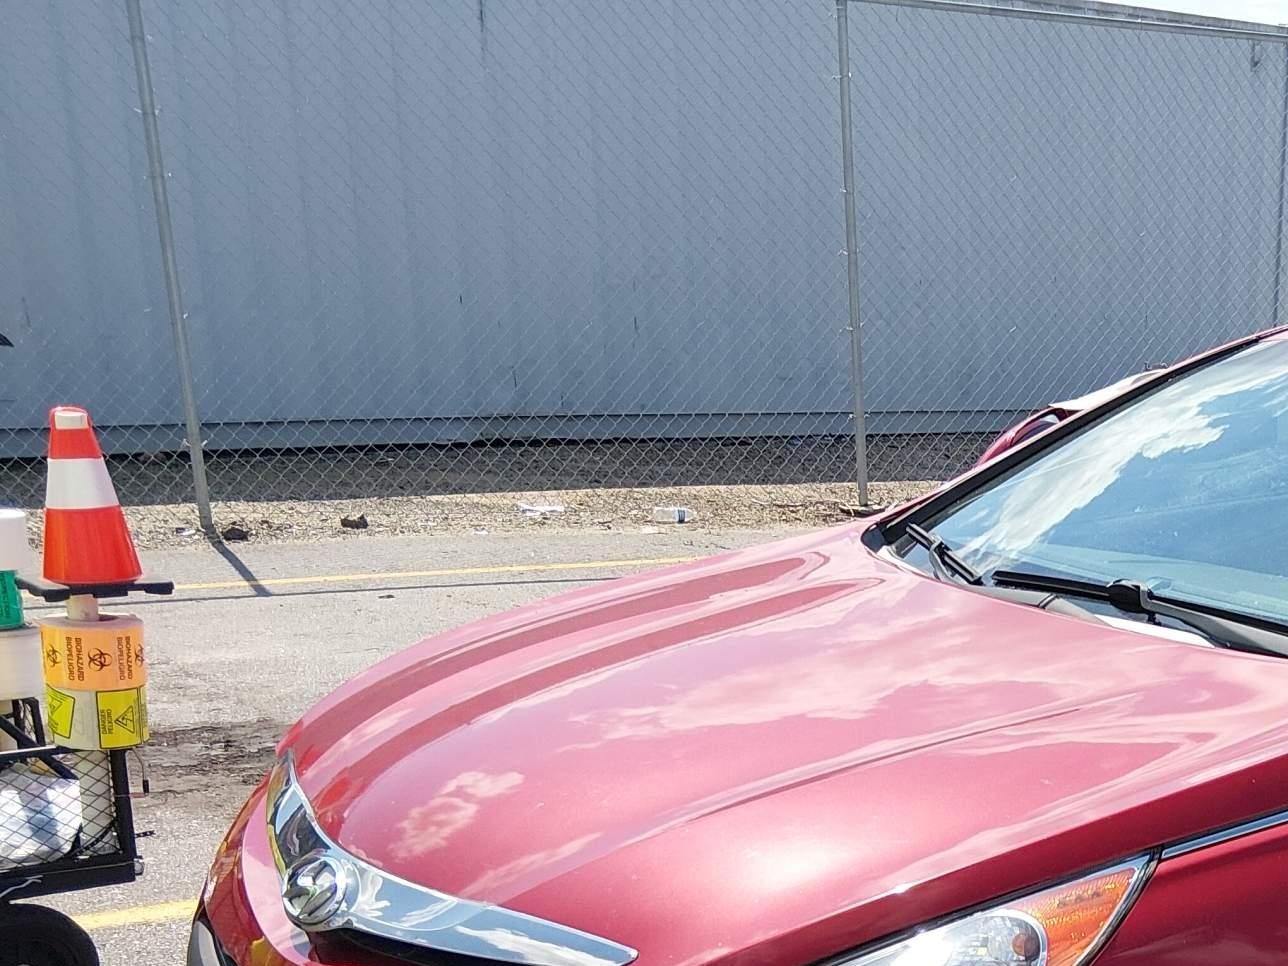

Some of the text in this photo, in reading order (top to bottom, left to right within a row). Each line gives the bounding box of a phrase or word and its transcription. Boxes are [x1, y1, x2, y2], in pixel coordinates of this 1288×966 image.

[65, 636, 75, 681] BIOPELIGRO
[74, 637, 84, 681] BIOHAZARD
[117, 636, 126, 680] BIOPELIGRO
[124, 635, 133, 680] BIOHAZARD
